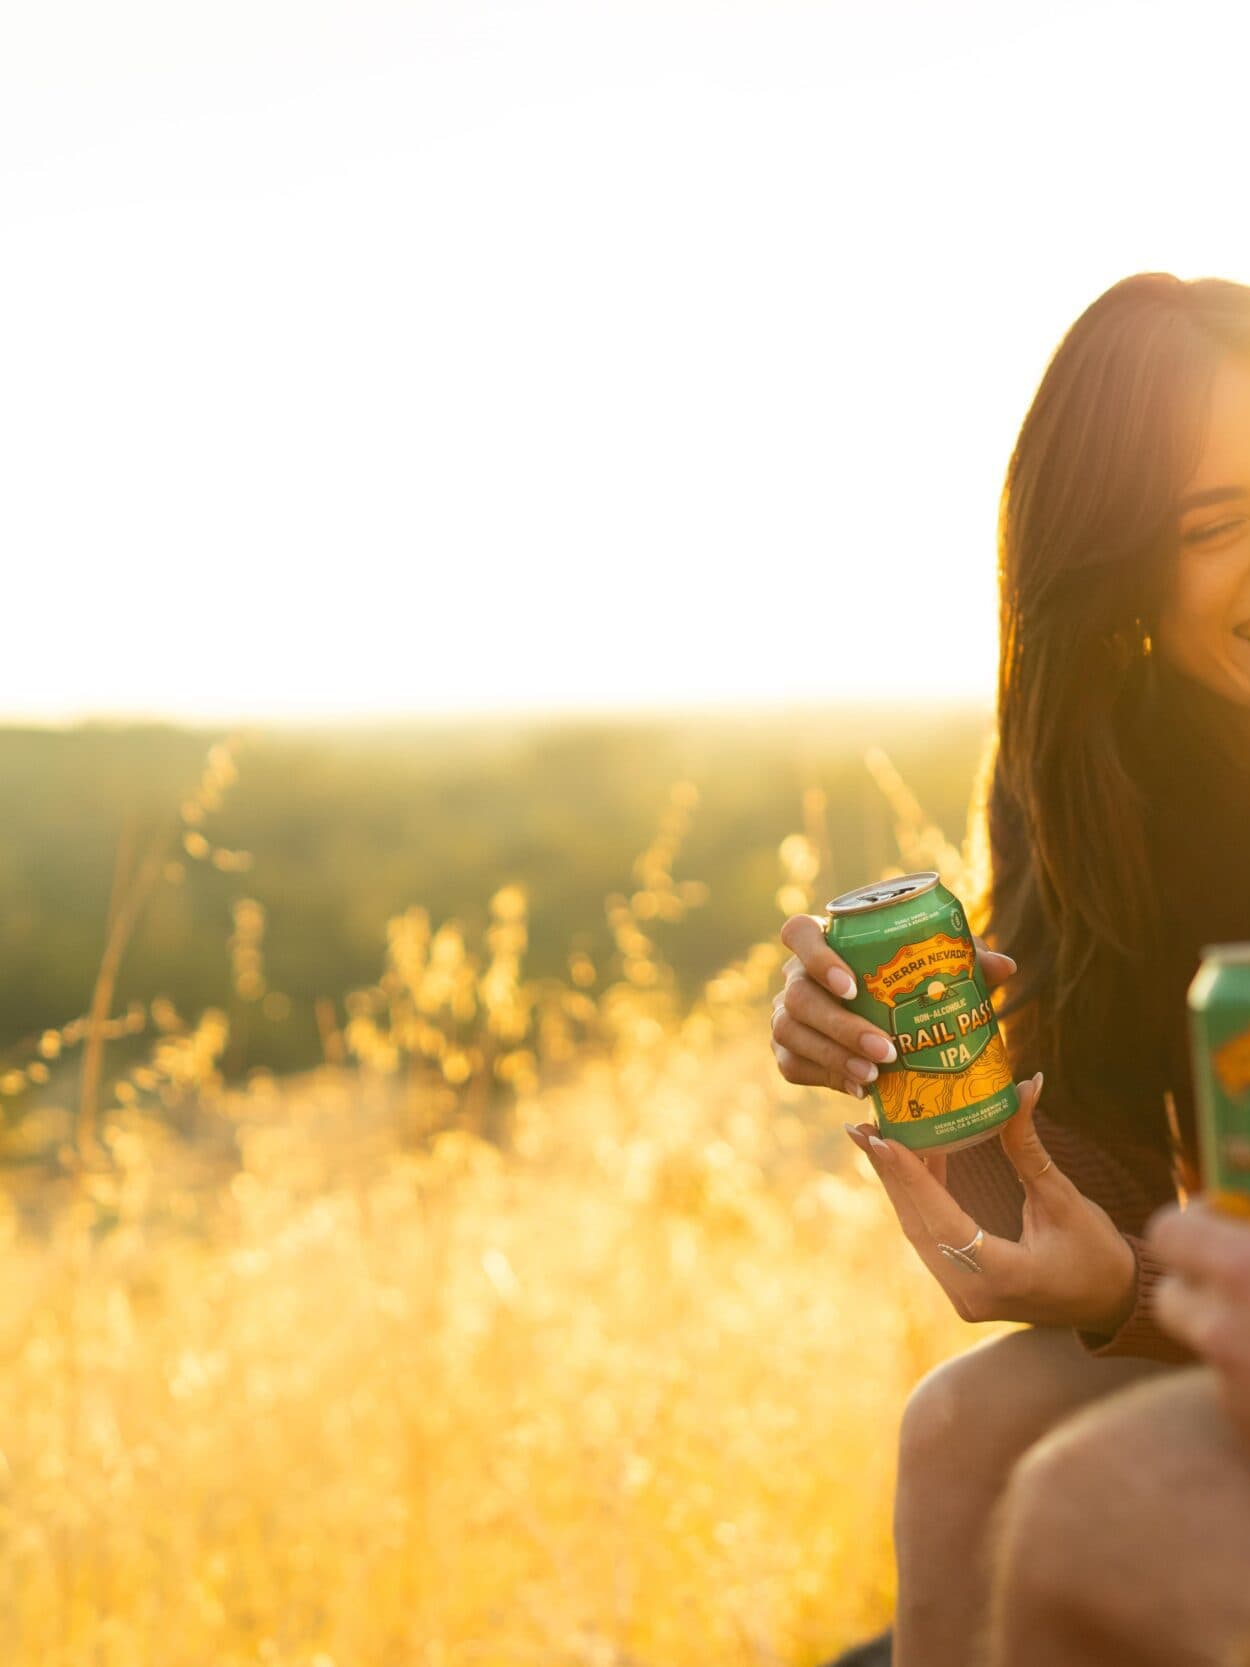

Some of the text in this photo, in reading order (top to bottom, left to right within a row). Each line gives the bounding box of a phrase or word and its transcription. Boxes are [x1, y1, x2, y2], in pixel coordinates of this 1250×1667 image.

[882, 949, 966, 988] SIERRA NEVADA
[913, 998, 967, 1024] NON-ALCOHOLIC
[892, 1023, 955, 1054] RAIL
[940, 1043, 971, 1068] IPA
